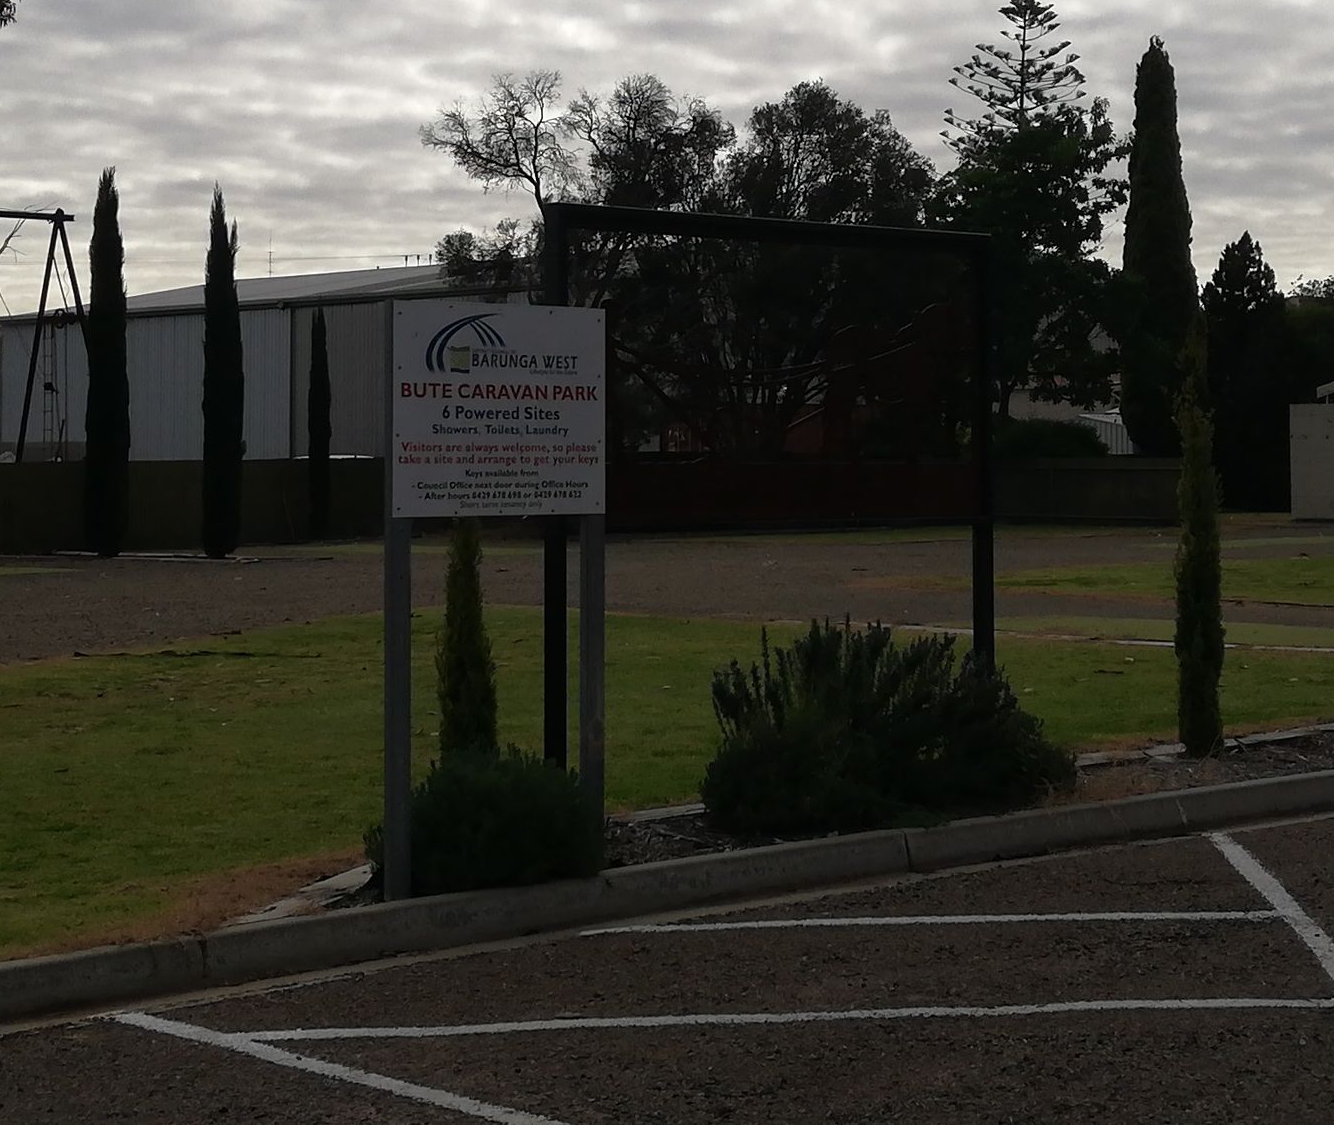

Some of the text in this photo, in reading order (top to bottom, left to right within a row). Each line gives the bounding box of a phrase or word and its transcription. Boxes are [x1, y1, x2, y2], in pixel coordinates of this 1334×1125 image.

[472, 353, 578, 370] BARUNGA WEST
[401, 382, 598, 401] BUTE CARAVAN PARK
[442, 405, 560, 420] 6 Powered Sites
[526, 425, 569, 437] Laundry
[401, 441, 443, 452] Visitors
[446, 444, 462, 452] are
[466, 442, 499, 454] always
[502, 443, 550, 454] welcome,
[566, 443, 597, 454] please
[398, 455, 421, 464] take
[434, 455, 453, 464] site
[456, 454, 474, 464] and
[477, 456, 517, 466] arrange
[520, 455, 531, 464] to
[533, 455, 549, 466] get
[553, 457, 575, 466] your
[578, 455, 599, 466] keys
[417, 481, 448, 490] Council
[449, 481, 473, 489] Office
